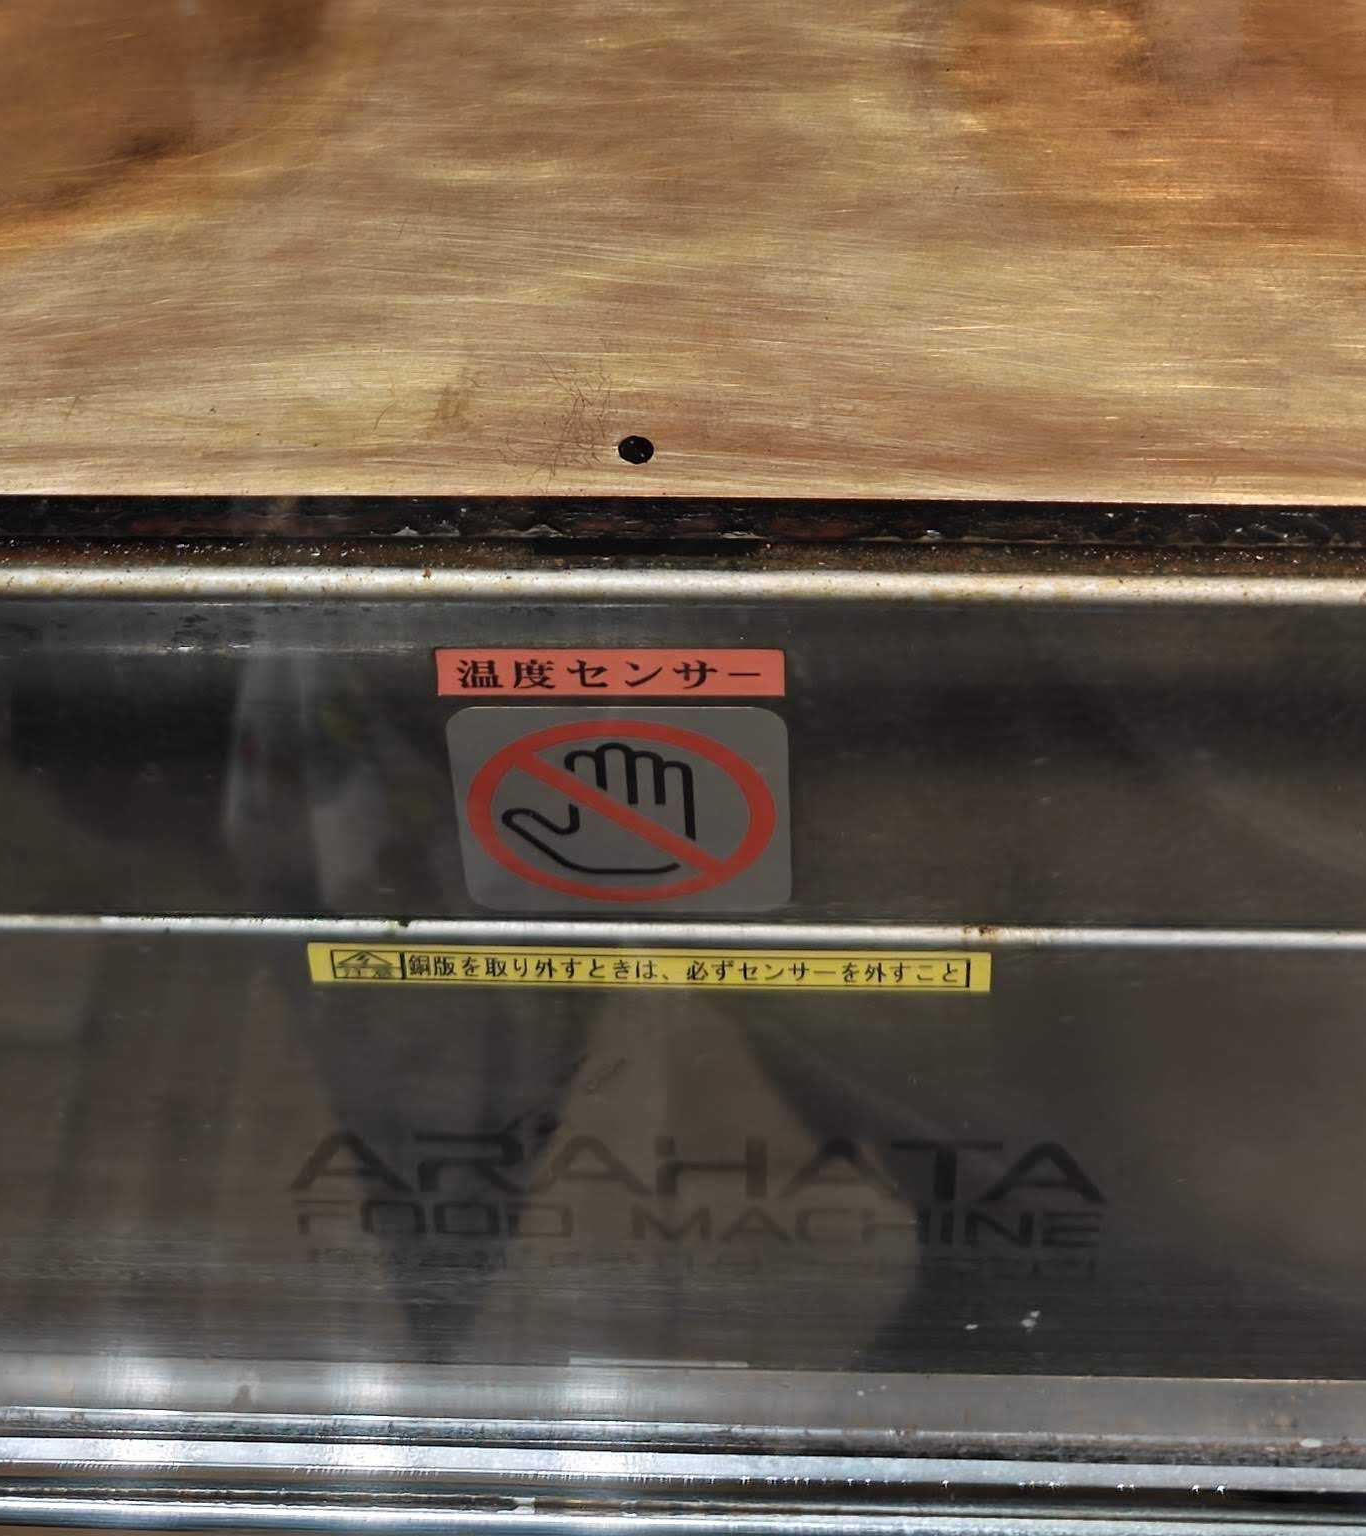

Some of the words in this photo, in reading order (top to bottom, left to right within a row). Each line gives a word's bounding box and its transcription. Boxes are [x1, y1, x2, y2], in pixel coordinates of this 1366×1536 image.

[456, 659, 761, 689] 温度センサー
[290, 1132, 1107, 1204] ARAHATA
[294, 1199, 573, 1238] FOOD
[631, 1204, 1103, 1247] MACHINE
